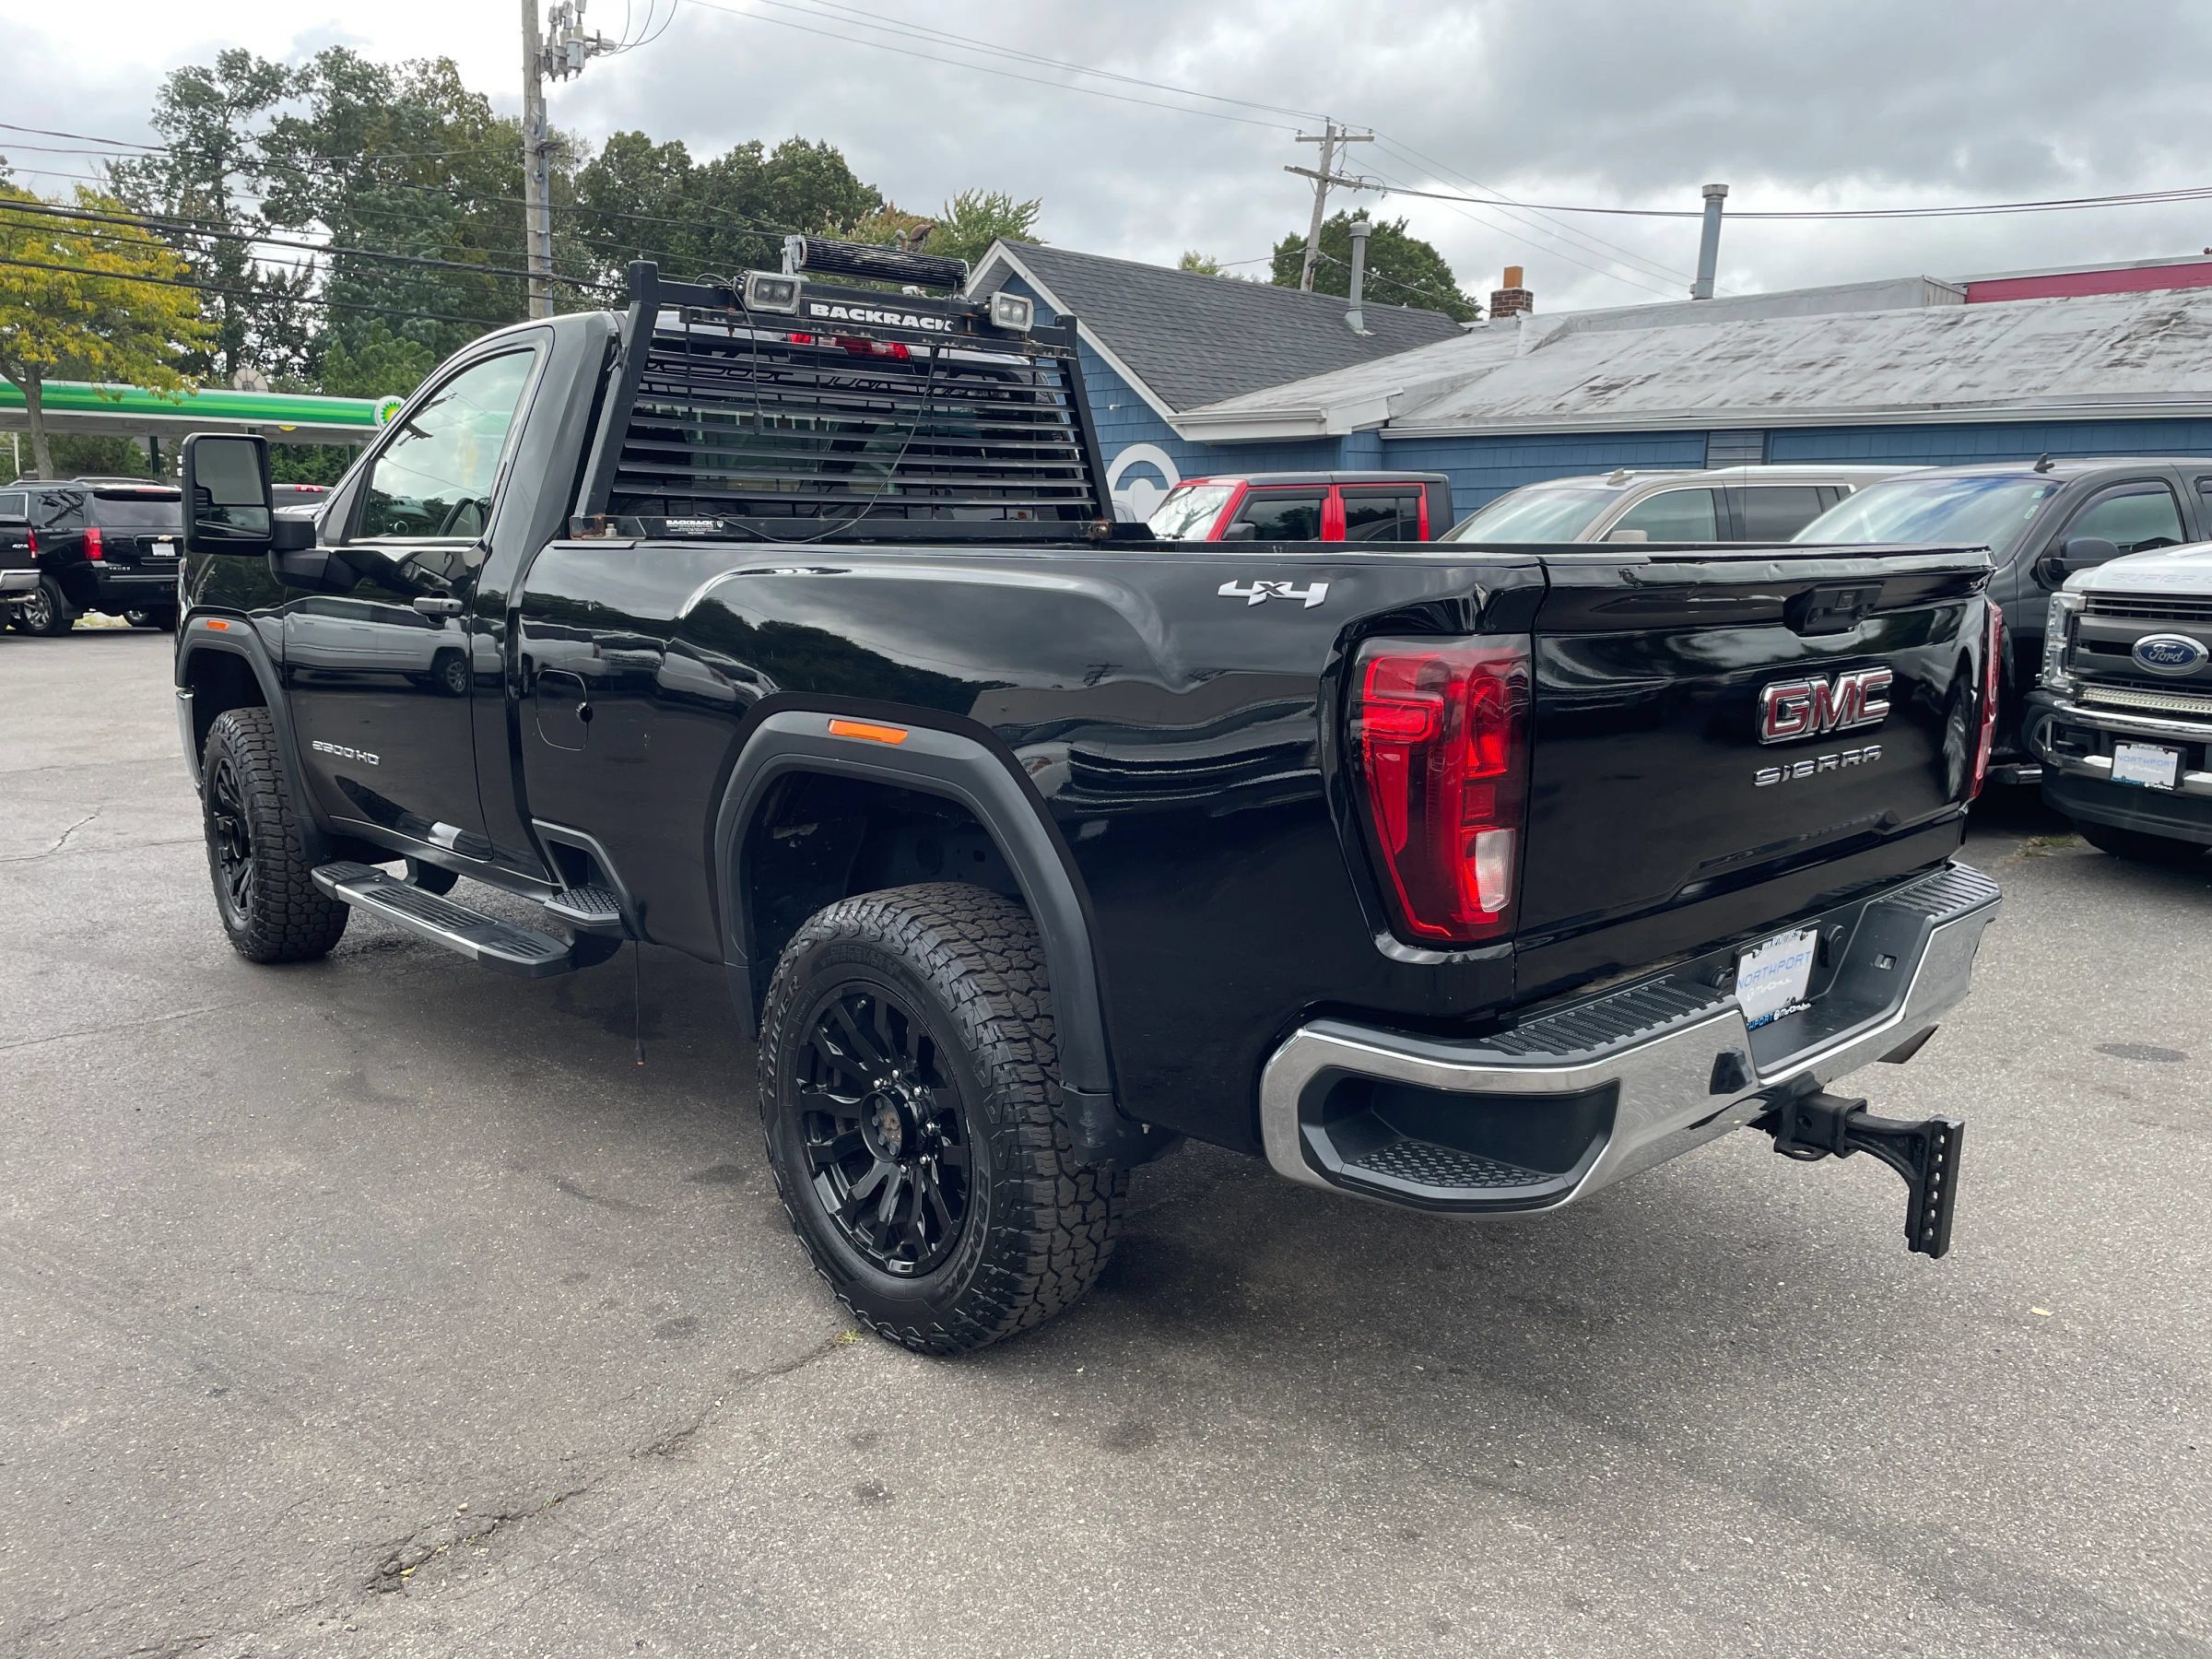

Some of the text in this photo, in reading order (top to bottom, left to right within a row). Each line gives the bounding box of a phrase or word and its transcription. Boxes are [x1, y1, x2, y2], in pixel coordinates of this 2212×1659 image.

[810, 303, 954, 332] BACKRACK
[2110, 573, 2198, 583] SUPER
[2148, 643, 2184, 663] Ford
[1759, 667, 1892, 744] GMC
[1753, 745, 1883, 787] SIERRA
[2116, 754, 2176, 767] NORTHPORT
[1737, 950, 1812, 990] NORTHPORT
